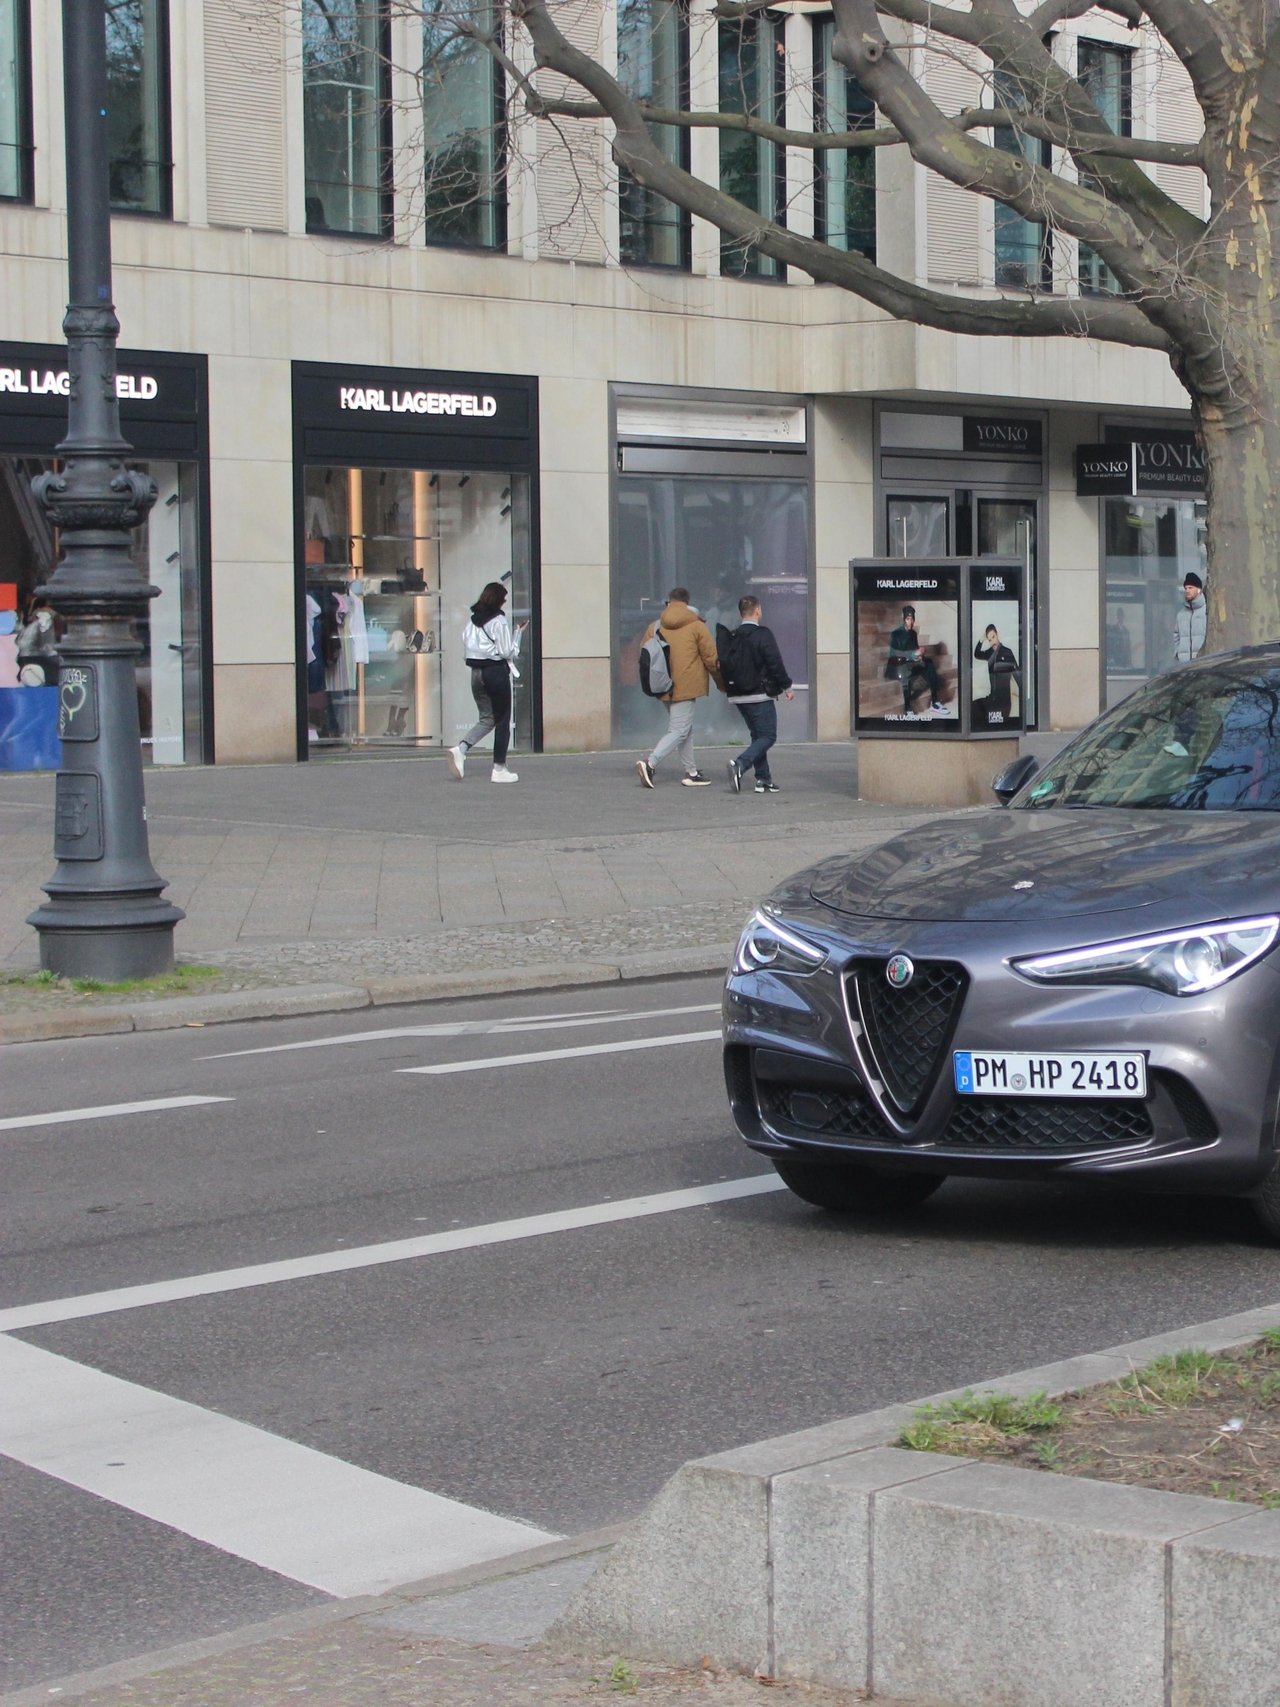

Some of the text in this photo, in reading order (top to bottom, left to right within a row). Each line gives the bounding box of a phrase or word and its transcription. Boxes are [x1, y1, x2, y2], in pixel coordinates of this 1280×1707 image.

[341, 387, 497, 417] KARL LAGERFELD
[976, 425, 1028, 441] YONKO
[1083, 461, 1128, 473] YONKO
[1140, 472, 1165, 480] PREMIUM
[1167, 473, 1191, 482] BEAUTY
[877, 580, 938, 588] KARL LAGERFELD
[986, 576, 1005, 587] KARL
[885, 714, 933, 722] KARL LAGERFELD
[989, 711, 1003, 719] KARL
[961, 1058, 1139, 1091] D PM HP 2418
